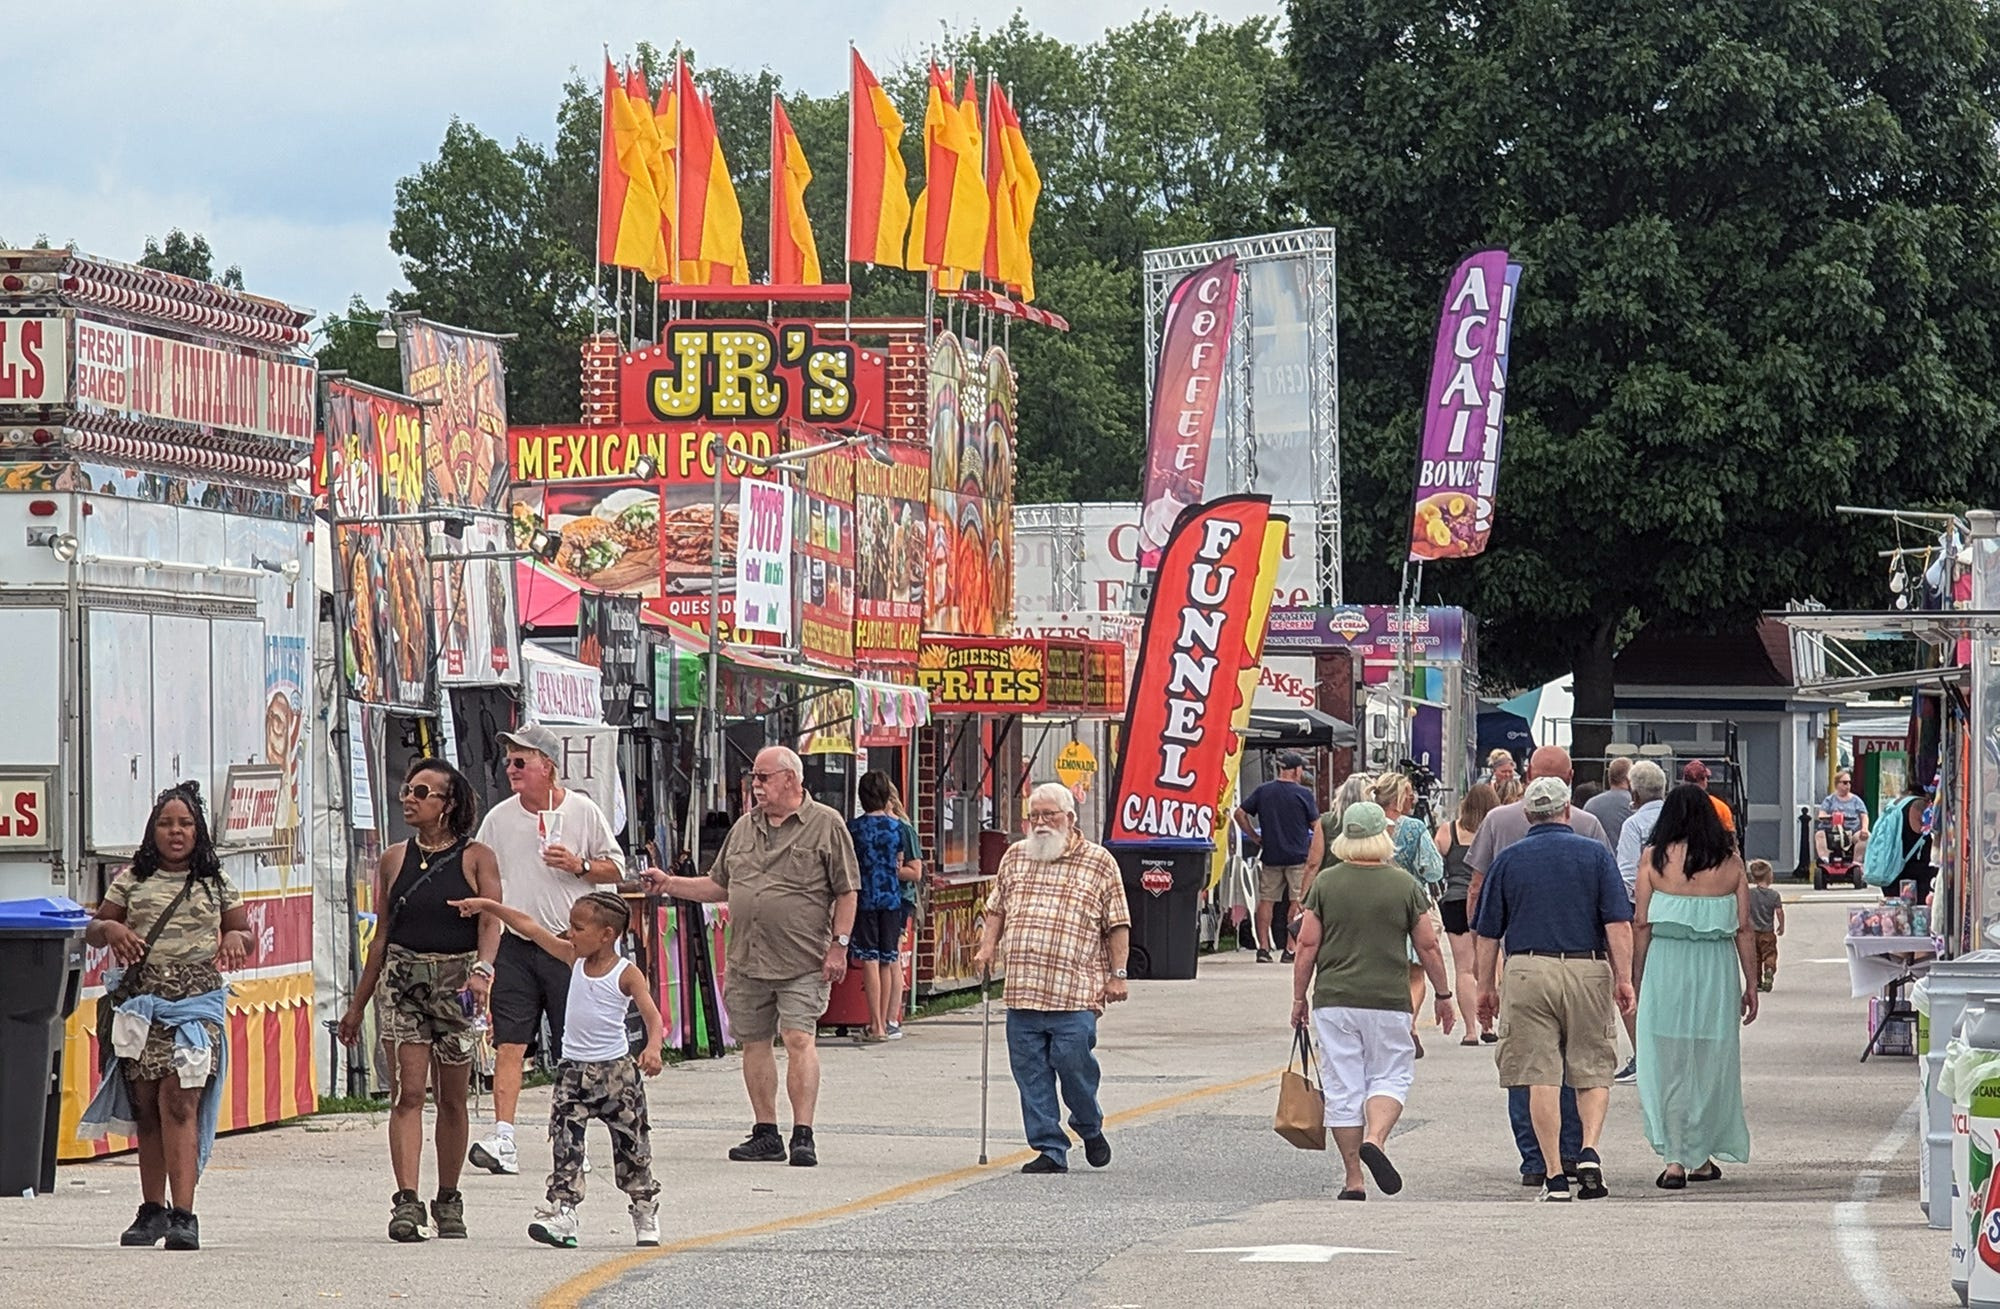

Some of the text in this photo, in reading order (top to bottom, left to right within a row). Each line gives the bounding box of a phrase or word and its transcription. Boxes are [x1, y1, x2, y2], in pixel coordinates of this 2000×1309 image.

[79, 325, 125, 367] FRESH
[1440, 267, 1490, 453] ACAI
[79, 365, 126, 406] BAKED
[131, 334, 313, 444] HOT CINNAMON ROLLS
[653, 330, 850, 418] JR's
[1174, 277, 1221, 471] COFFEE
[517, 432, 667, 480] MEXICAN
[680, 431, 771, 477] FOOD
[1343, 622, 1368, 630] CREAM
[949, 649, 1010, 669] CHEESE
[1159, 518, 1241, 789] FUNNEL
[918, 670, 1041, 702] FRIES
[1257, 666, 1316, 707] AKES
[1057, 759, 1096, 772] LEMONADE
[1865, 741, 1900, 751] ATM
[1123, 793, 1213, 838] CAKES
[1144, 873, 1170, 883] PENN
